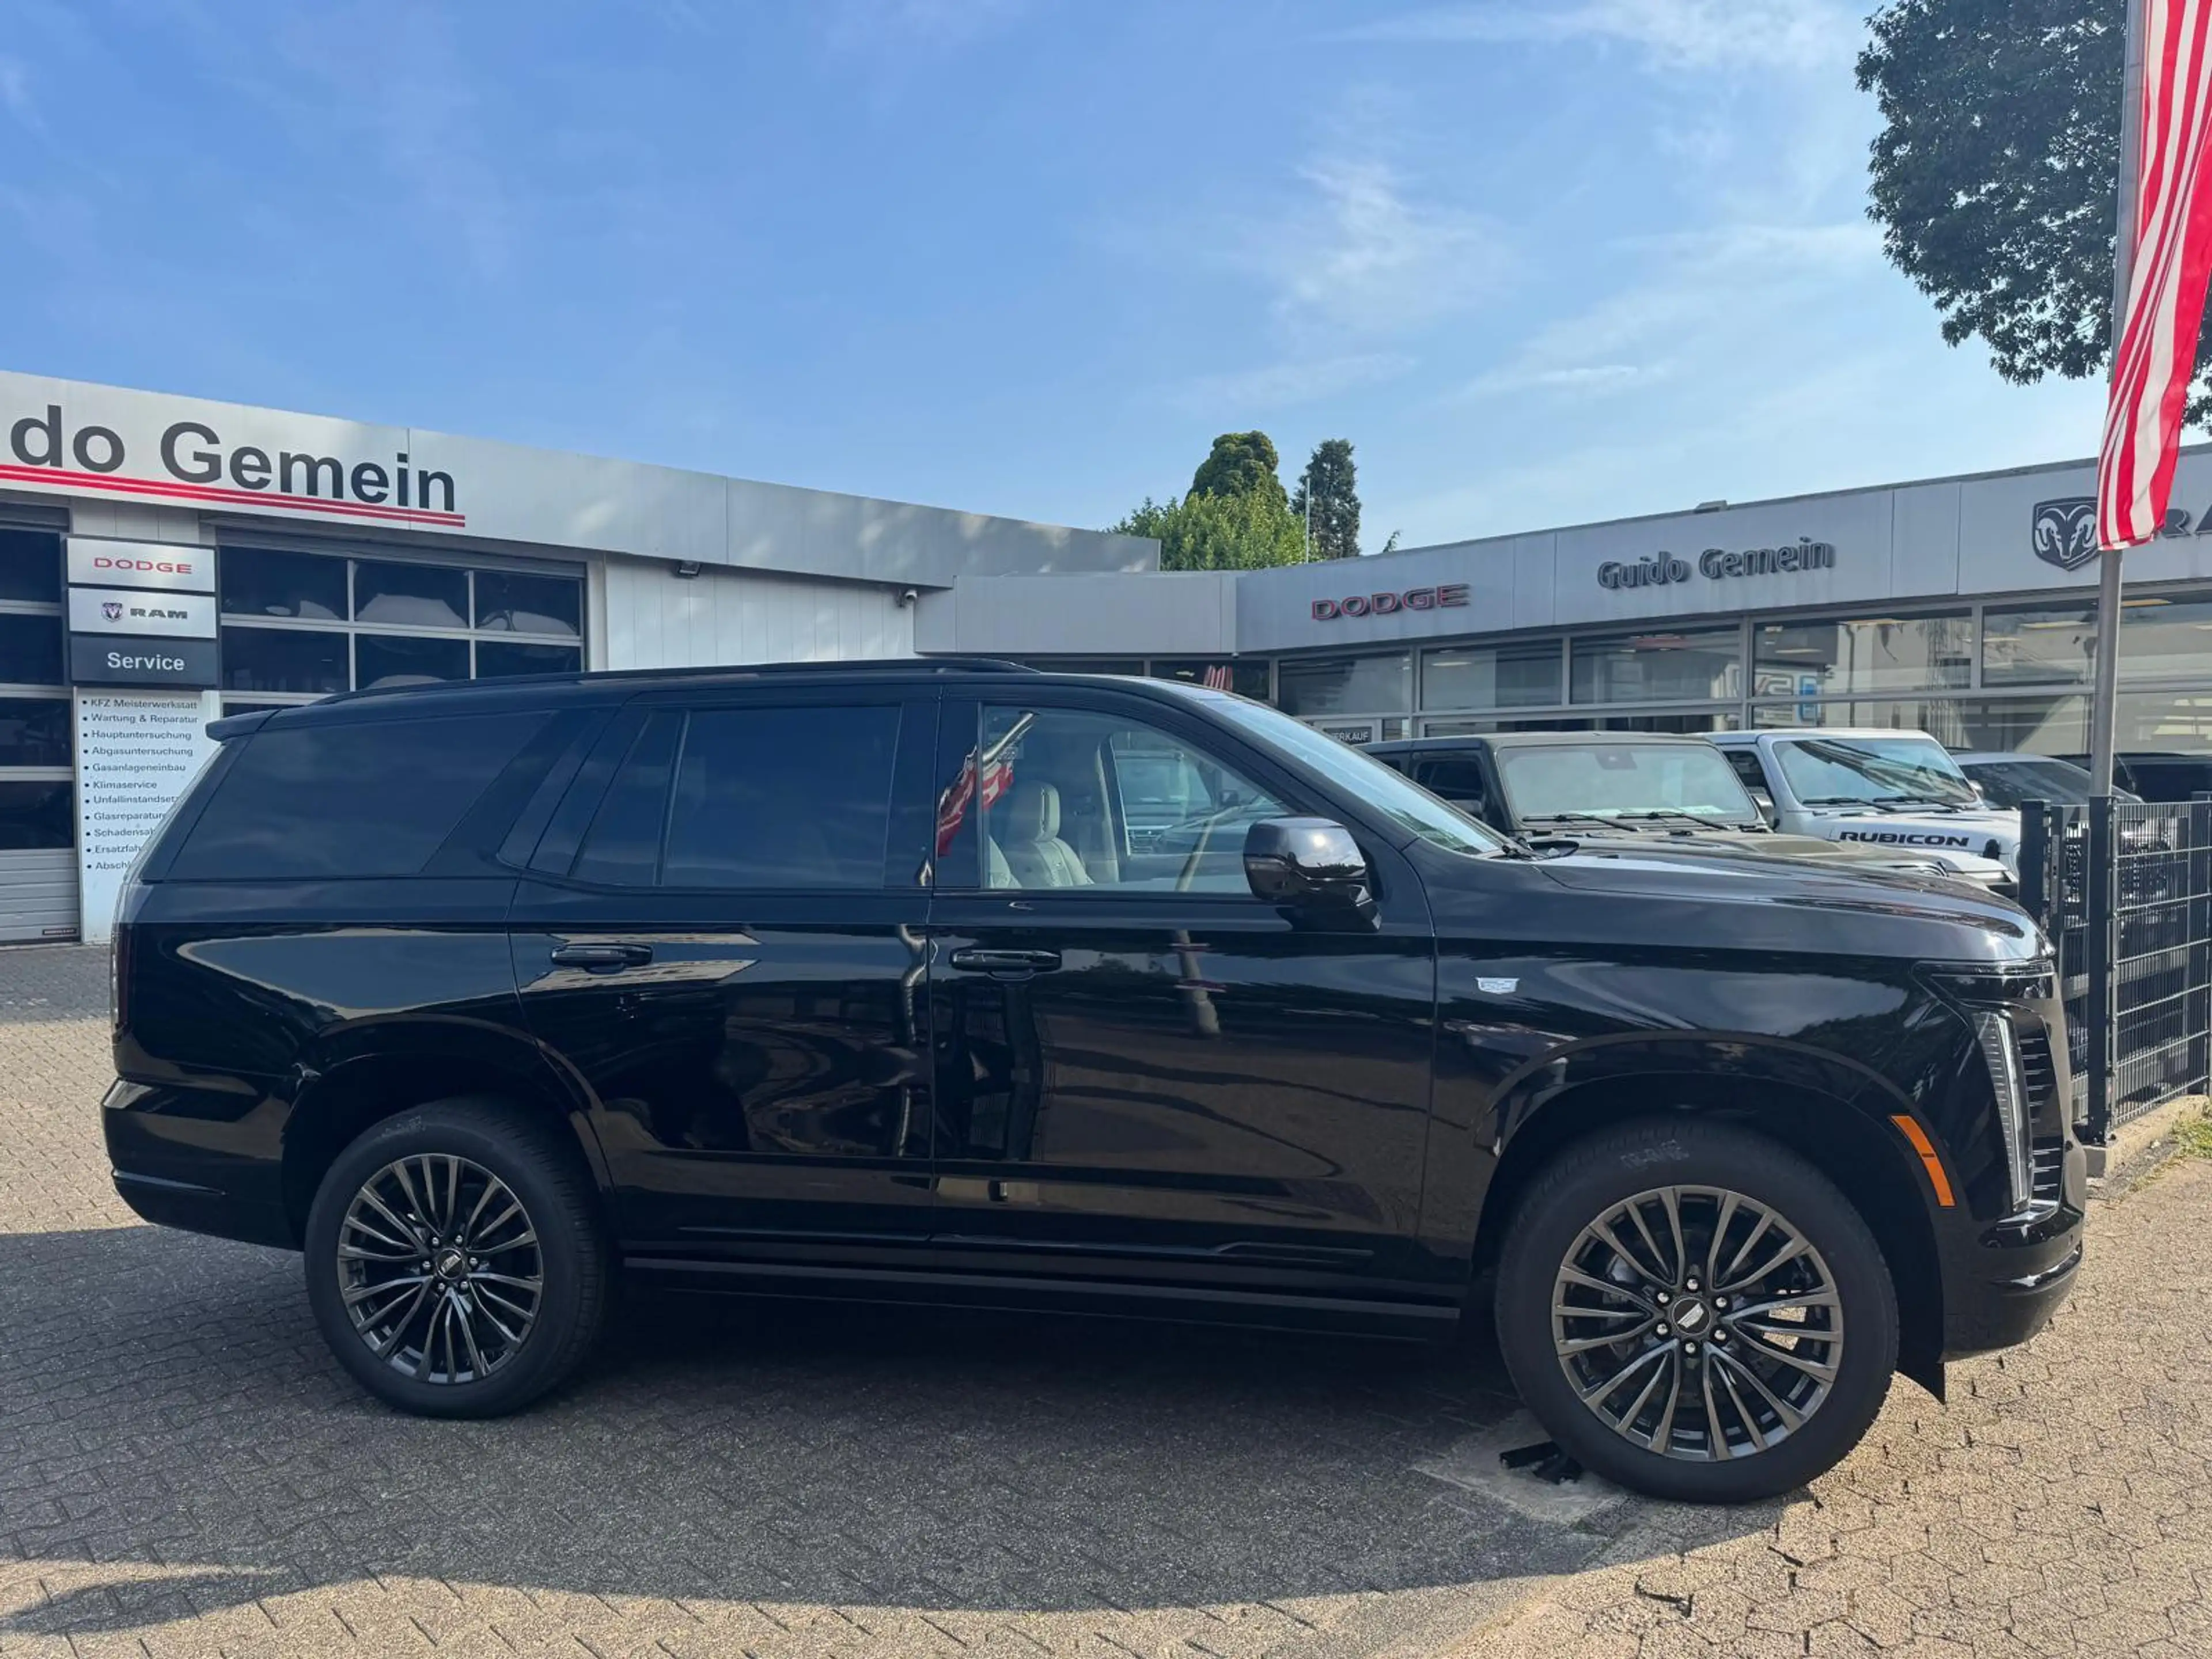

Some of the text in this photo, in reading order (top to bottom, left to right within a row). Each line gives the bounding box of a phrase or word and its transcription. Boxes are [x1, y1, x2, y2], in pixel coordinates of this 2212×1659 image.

[160, 421, 456, 513] Gemein
[93, 557, 192, 574] DODGE
[1597, 536, 1836, 590] Guido Gemein
[1311, 583, 1471, 621] DODGE
[130, 608, 188, 620] RAM
[107, 652, 185, 671] Service
[91, 698, 197, 709] KFZ Meisterwerkstatt
[91, 713, 136, 724] Wartung
[150, 714, 198, 724] Reparatur
[91, 730, 192, 741] Hauptuntersuchung
[92, 747, 194, 757] Abgasuntersuchung
[92, 763, 186, 773] Gasanlageneinbau
[93, 781, 157, 789] Klimaservice
[1839, 831, 1970, 847] RUBICON
